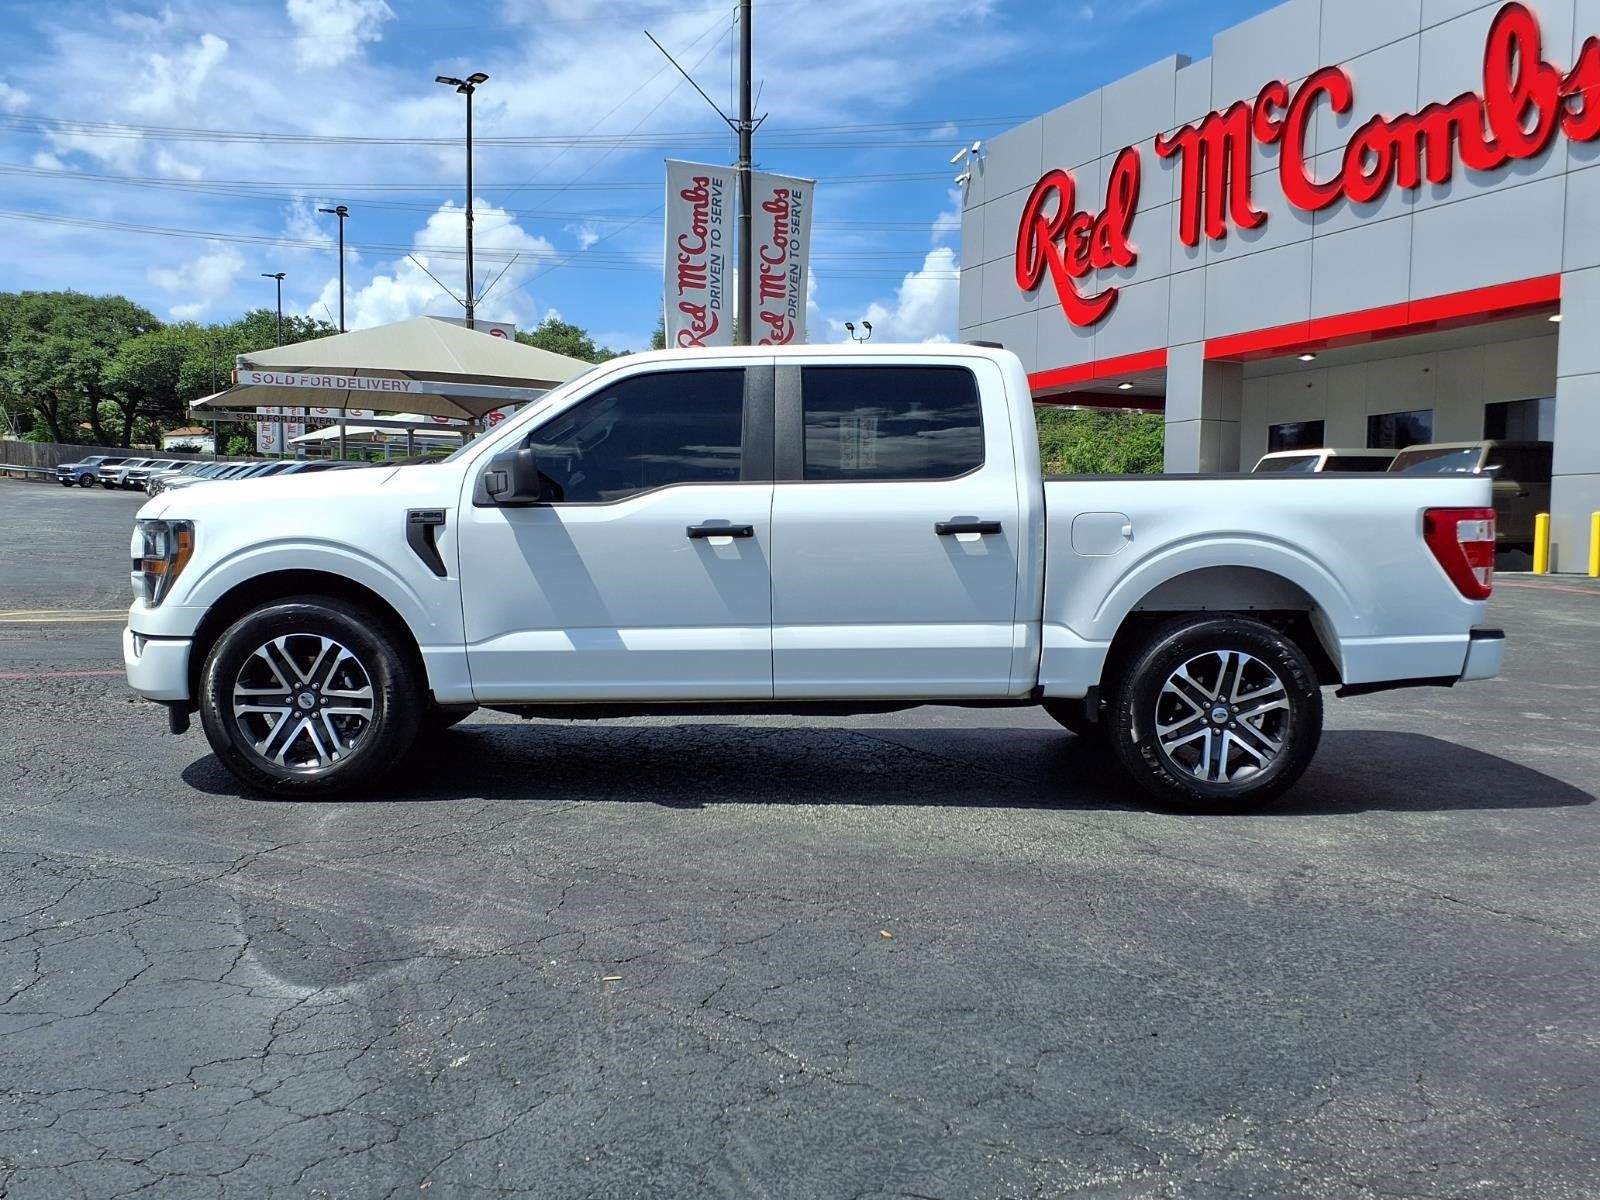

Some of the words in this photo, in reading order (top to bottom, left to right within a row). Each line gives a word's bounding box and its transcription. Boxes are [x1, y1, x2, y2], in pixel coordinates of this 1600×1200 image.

[1015, 145, 1141, 327] Red
[1154, 1, 1600, 247] McCombs
[711, 177, 722, 225] SERVE
[791, 190, 802, 234] SERVE
[677, 176, 710, 296] McCombs
[710, 229, 722, 248] TO
[759, 188, 790, 305] McCombs
[789, 239, 800, 259] TO
[710, 255, 723, 310] DRIVEN
[788, 264, 800, 319] DRIVEN
[677, 301, 719, 348] Red
[251, 372, 295, 385] SOLD
[300, 376, 332, 388] FOR
[336, 376, 411, 392] DELIVERY
[236, 413, 264, 422] SOLD
[267, 414, 288, 423] FOR
[292, 416, 338, 425] DELIVERY
